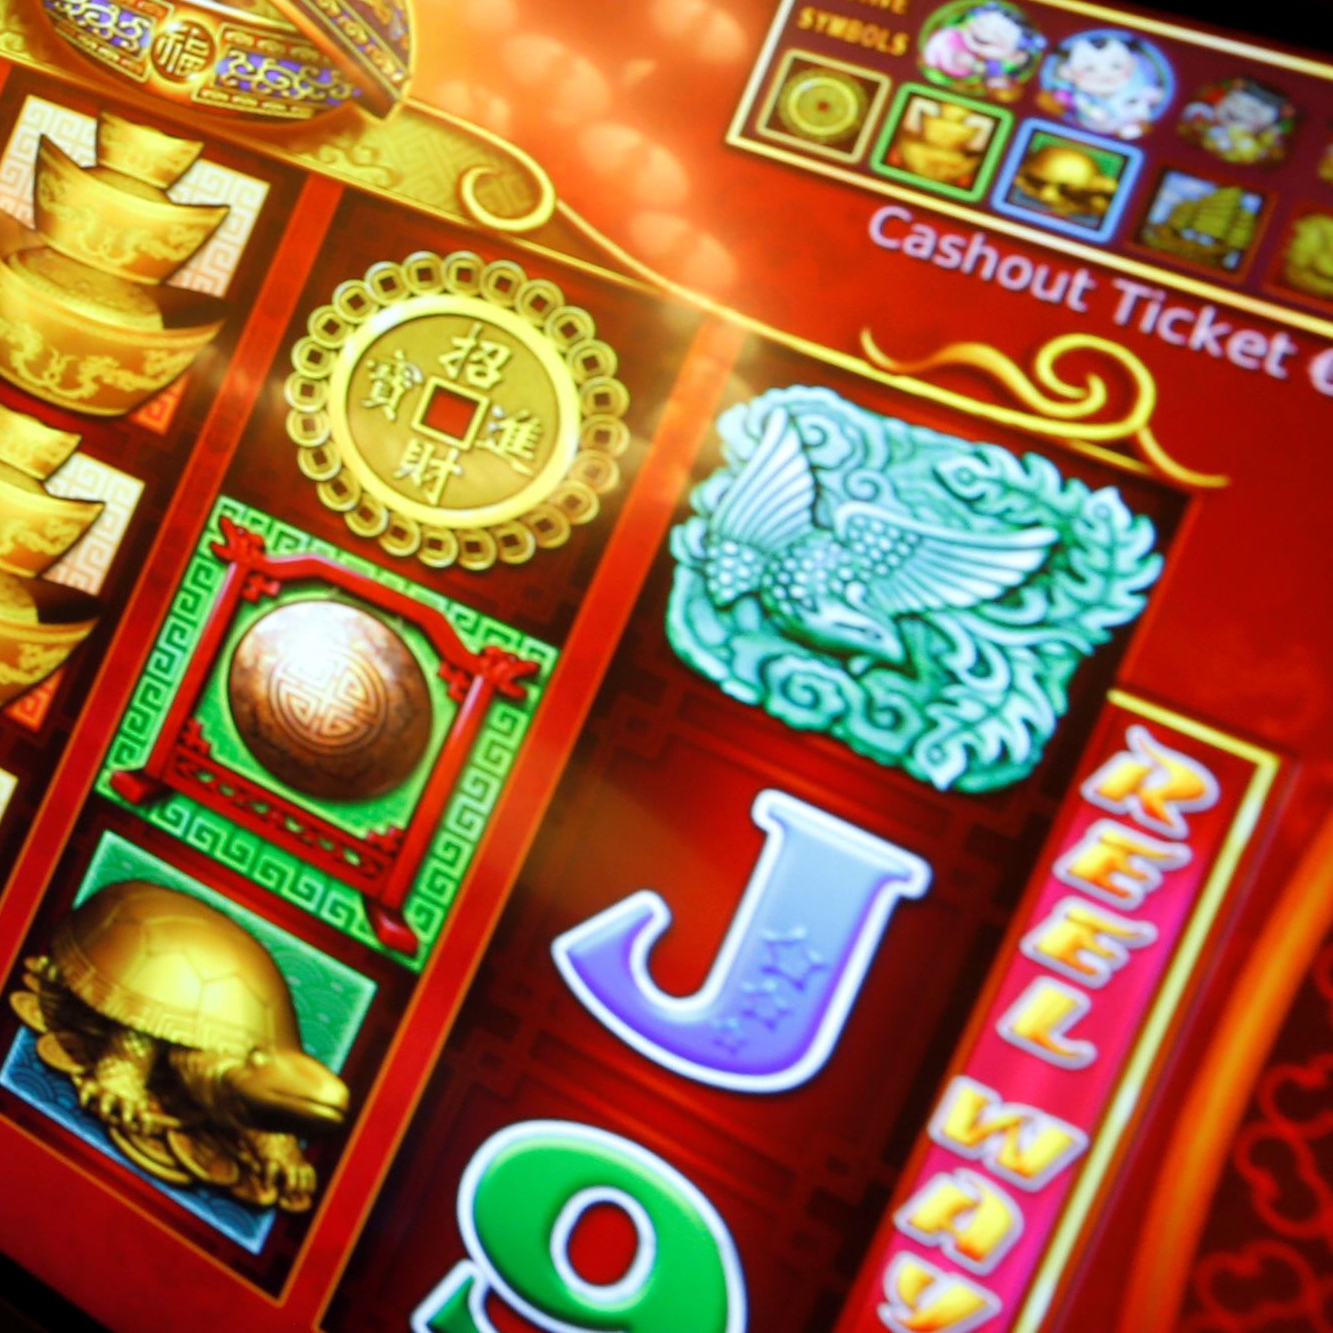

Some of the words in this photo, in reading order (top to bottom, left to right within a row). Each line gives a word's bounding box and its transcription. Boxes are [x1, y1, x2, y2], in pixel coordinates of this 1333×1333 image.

[797, 6, 909, 57] SYMBOLS
[868, 203, 1098, 314] Cashout
[1111, 277, 1297, 379] Ticket
[550, 786, 933, 1094] J
[997, 724, 1221, 1071] REEL
